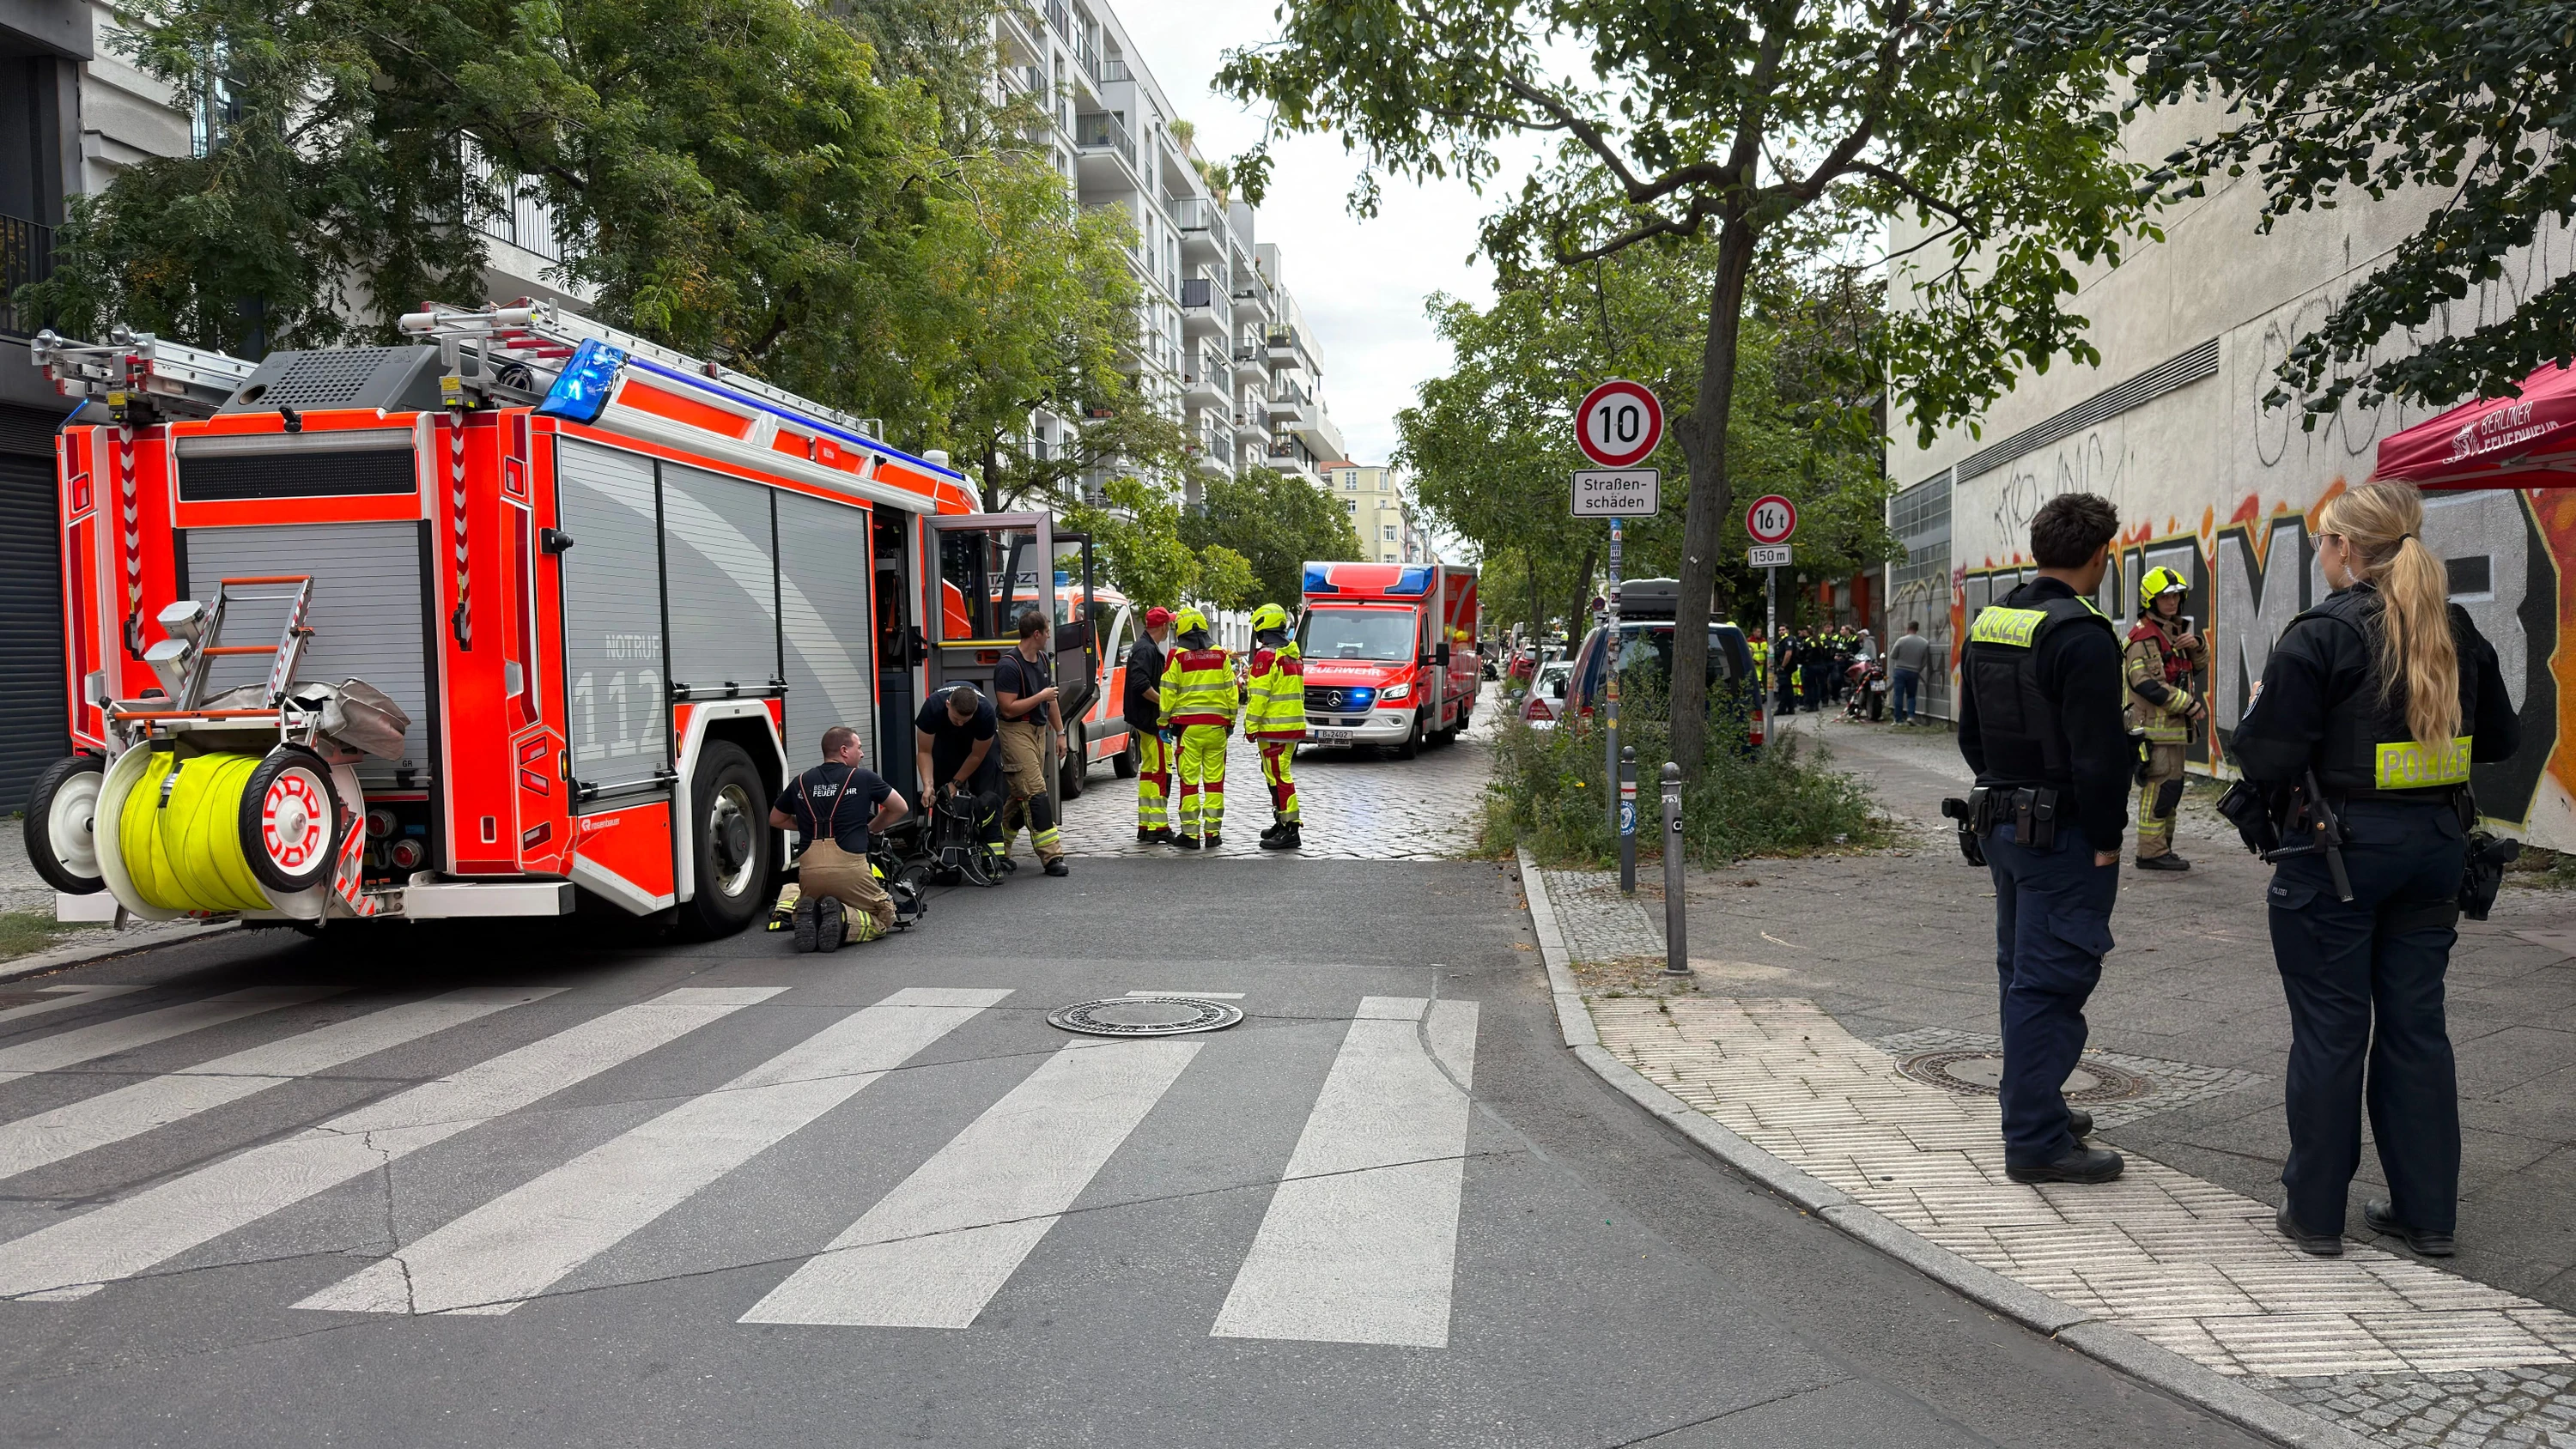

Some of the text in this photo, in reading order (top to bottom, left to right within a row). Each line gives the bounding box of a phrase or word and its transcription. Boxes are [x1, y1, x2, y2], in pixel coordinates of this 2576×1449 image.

[1600, 405, 1639, 443] 10
[2481, 401, 2533, 436] BERLINER
[1584, 478, 1647, 491] Straßen-
[1585, 494, 1644, 508] schäden
[1758, 509, 1784, 530] 16 t
[1753, 550, 1785, 562] 150 m
[605, 634, 659, 660] NOTRUF
[575, 669, 665, 761] 112
[812, 788, 857, 797] FEUERHR
